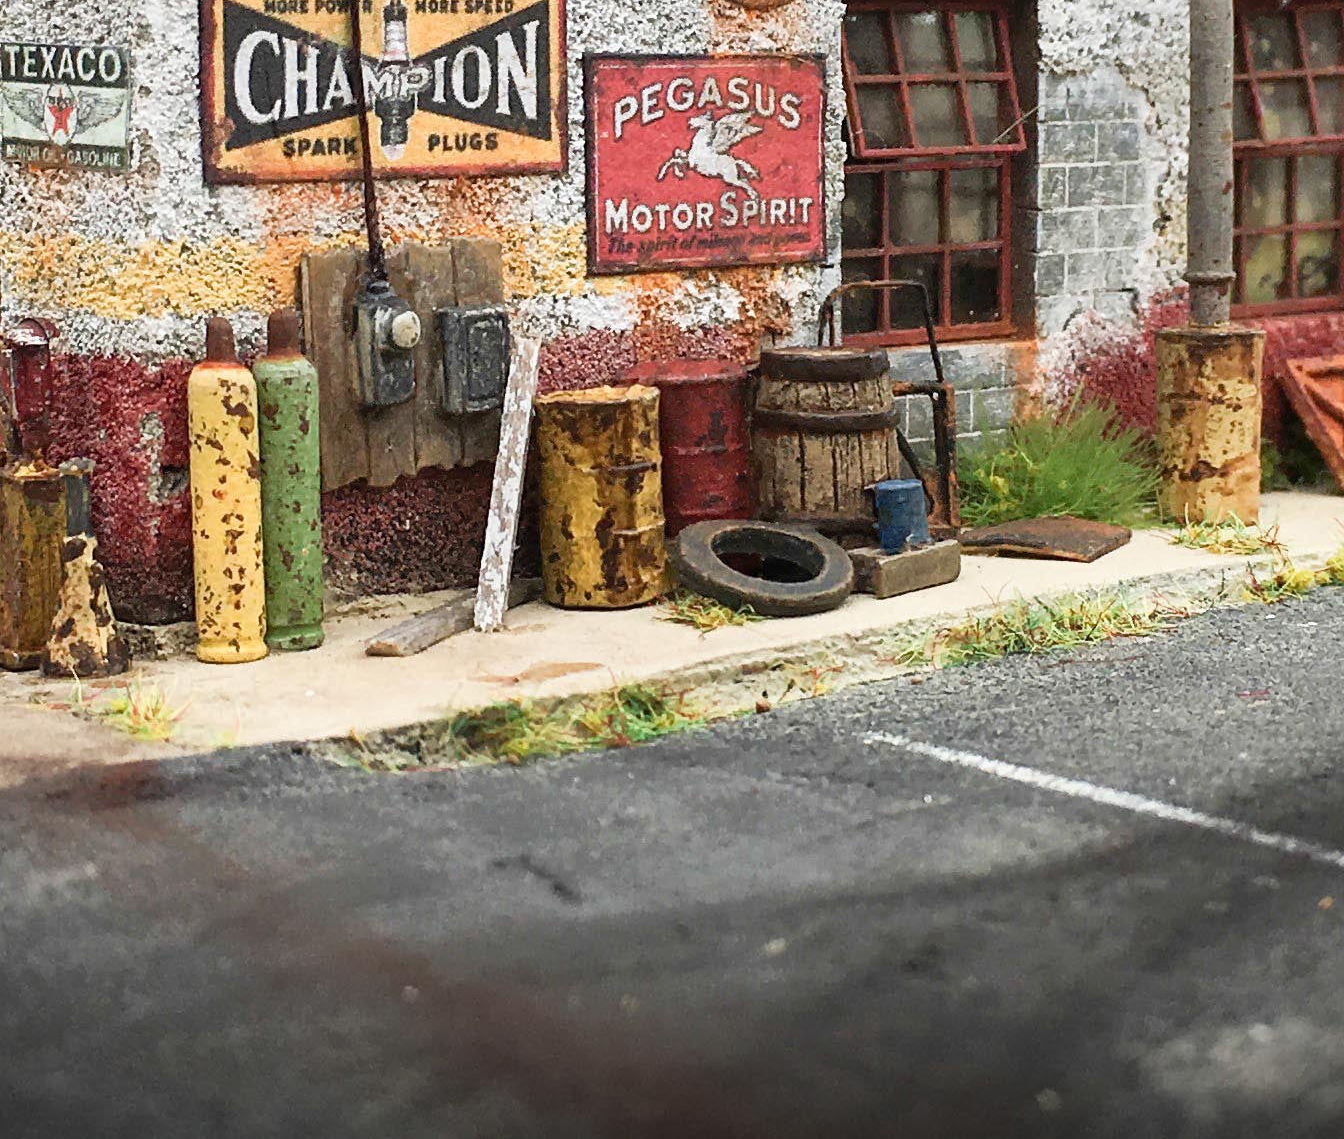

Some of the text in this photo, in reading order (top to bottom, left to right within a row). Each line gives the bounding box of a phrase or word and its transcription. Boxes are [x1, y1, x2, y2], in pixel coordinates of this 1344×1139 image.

[4, 45, 122, 83] TEXACO
[233, 19, 540, 125] CHAMPION
[613, 76, 802, 141] PEGASUS
[282, 132, 499, 158] SPARK PLUGS
[605, 190, 814, 235] MOTOR SPIRIT
[607, 237, 634, 255] The
[638, 235, 677, 254] spirit
[680, 234, 697, 250] of
